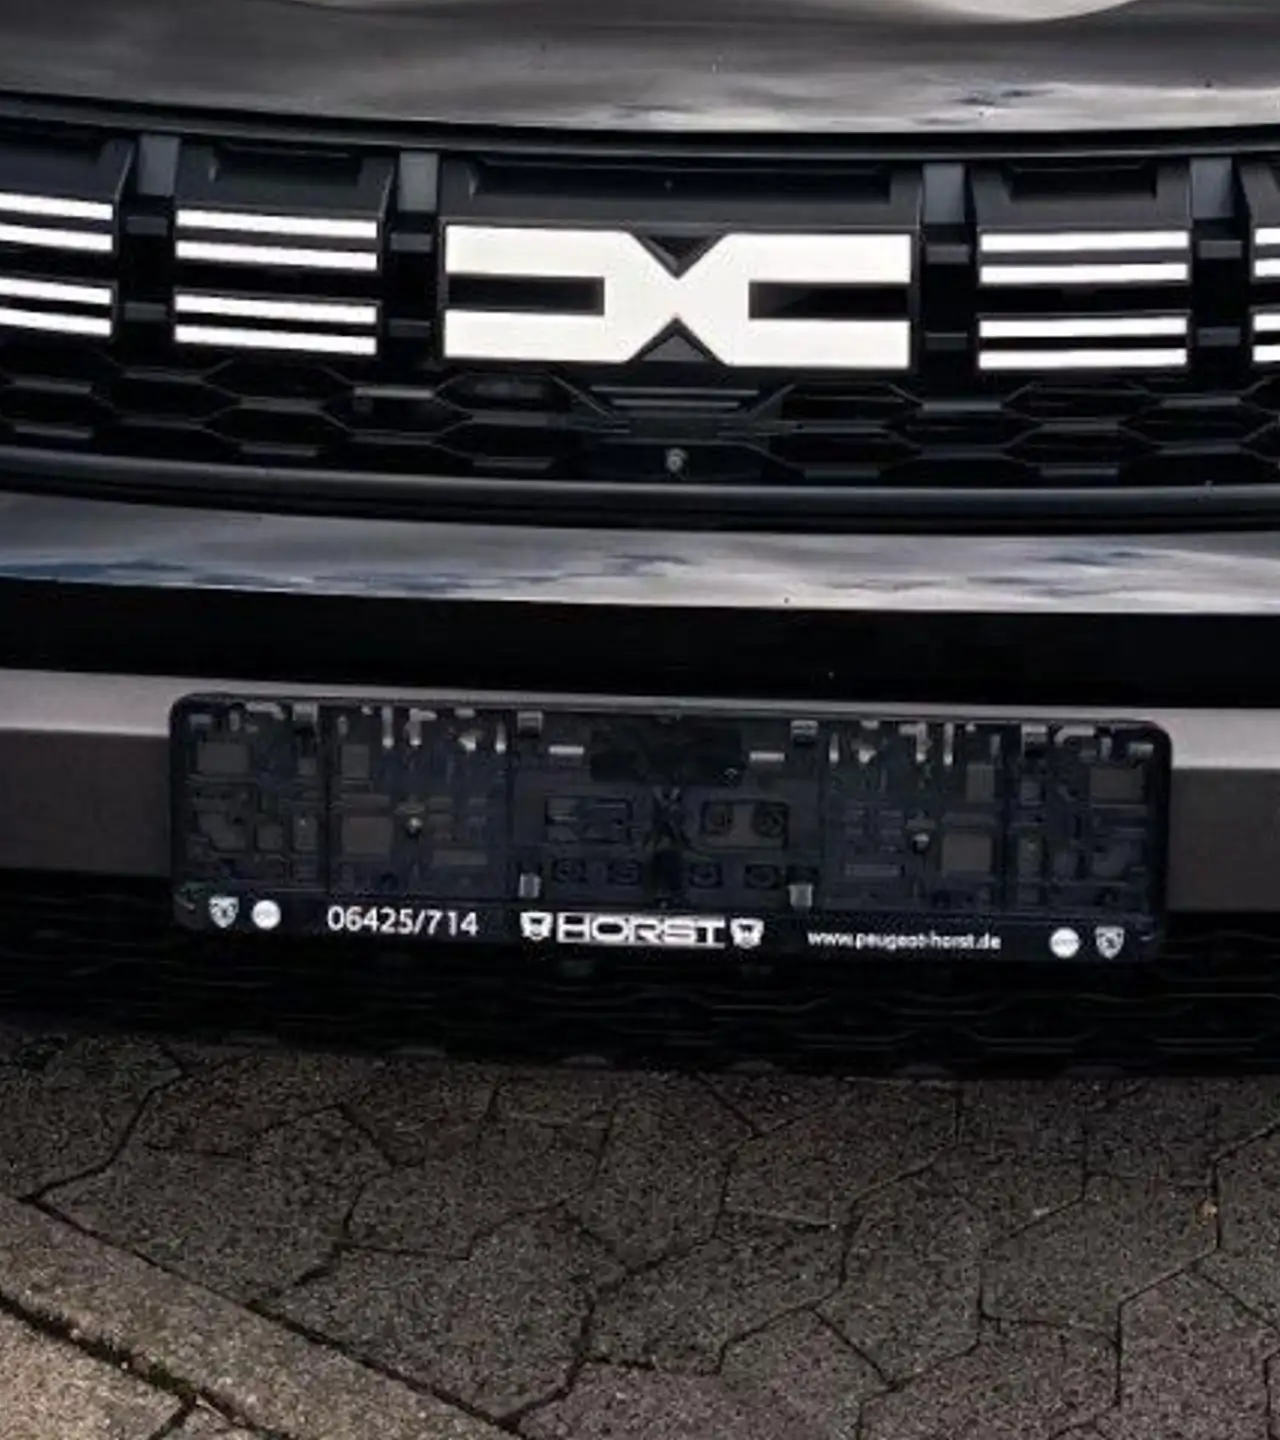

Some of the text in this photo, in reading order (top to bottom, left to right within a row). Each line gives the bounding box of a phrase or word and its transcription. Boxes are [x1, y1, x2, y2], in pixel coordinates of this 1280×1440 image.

[326, 905, 1002, 951] 06425/714 HORST www.peugeot-horst.de
